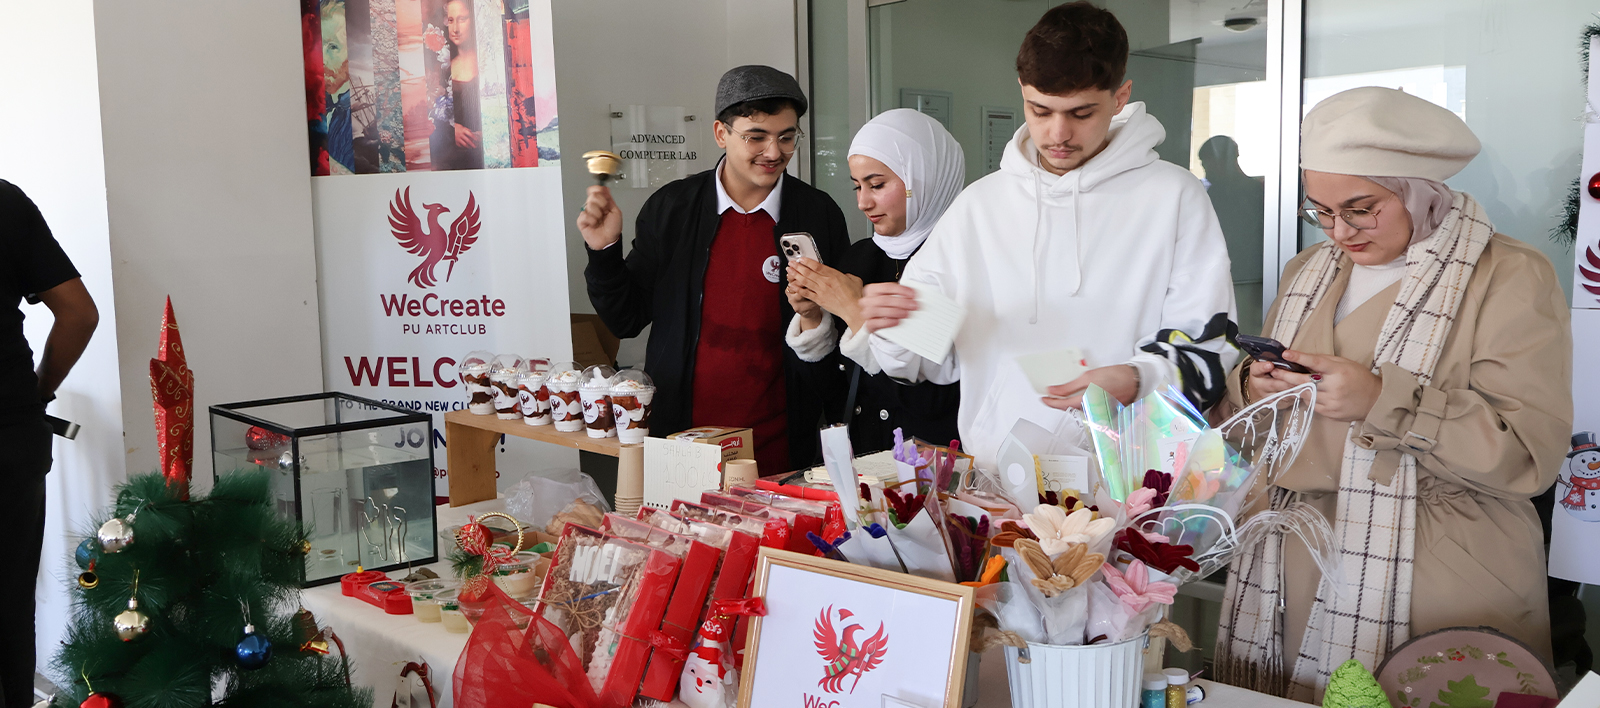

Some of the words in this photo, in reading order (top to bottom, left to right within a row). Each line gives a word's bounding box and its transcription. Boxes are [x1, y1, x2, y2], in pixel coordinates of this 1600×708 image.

[630, 134, 686, 144] ADVANCED
[619, 150, 676, 160] COMPUTER
[679, 151, 697, 160] LAB
[379, 292, 506, 317] WeCreate
[402, 324, 421, 335] PU
[425, 324, 487, 335] ARTCLUB
[343, 356, 550, 388] WELCOE
[339, 399, 354, 409] TO
[425, 400, 449, 412] NEW
[452, 401, 471, 412] CL
[394, 427, 447, 450] JON
